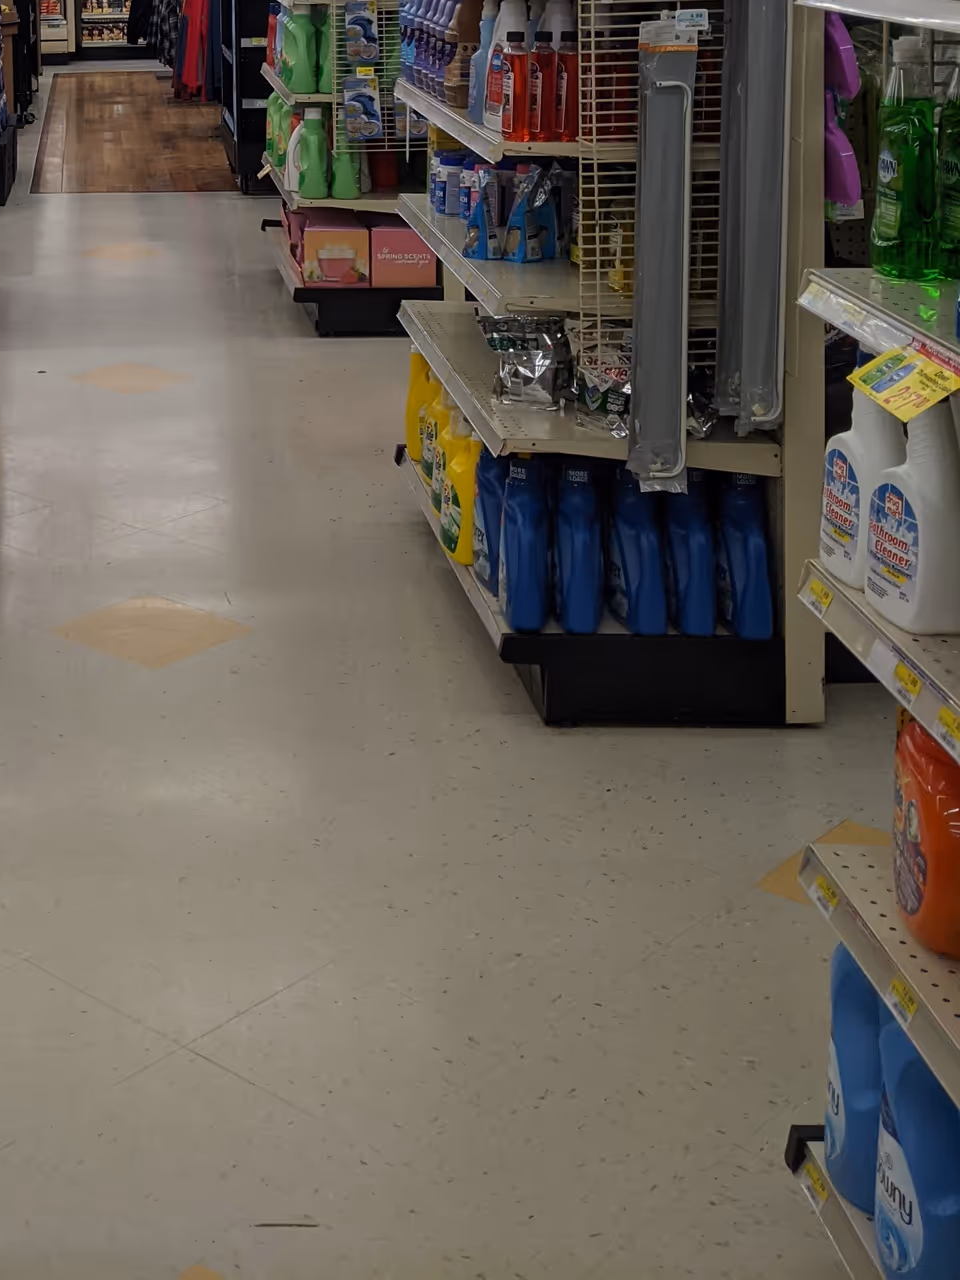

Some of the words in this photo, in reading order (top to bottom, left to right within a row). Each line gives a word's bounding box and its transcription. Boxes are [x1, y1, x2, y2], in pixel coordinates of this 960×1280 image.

[377, 253, 403, 261] SPRING
[825, 502, 854, 529] Cleaner
[875, 538, 911, 569] Cleaner
[879, 1168, 913, 1226] owny
